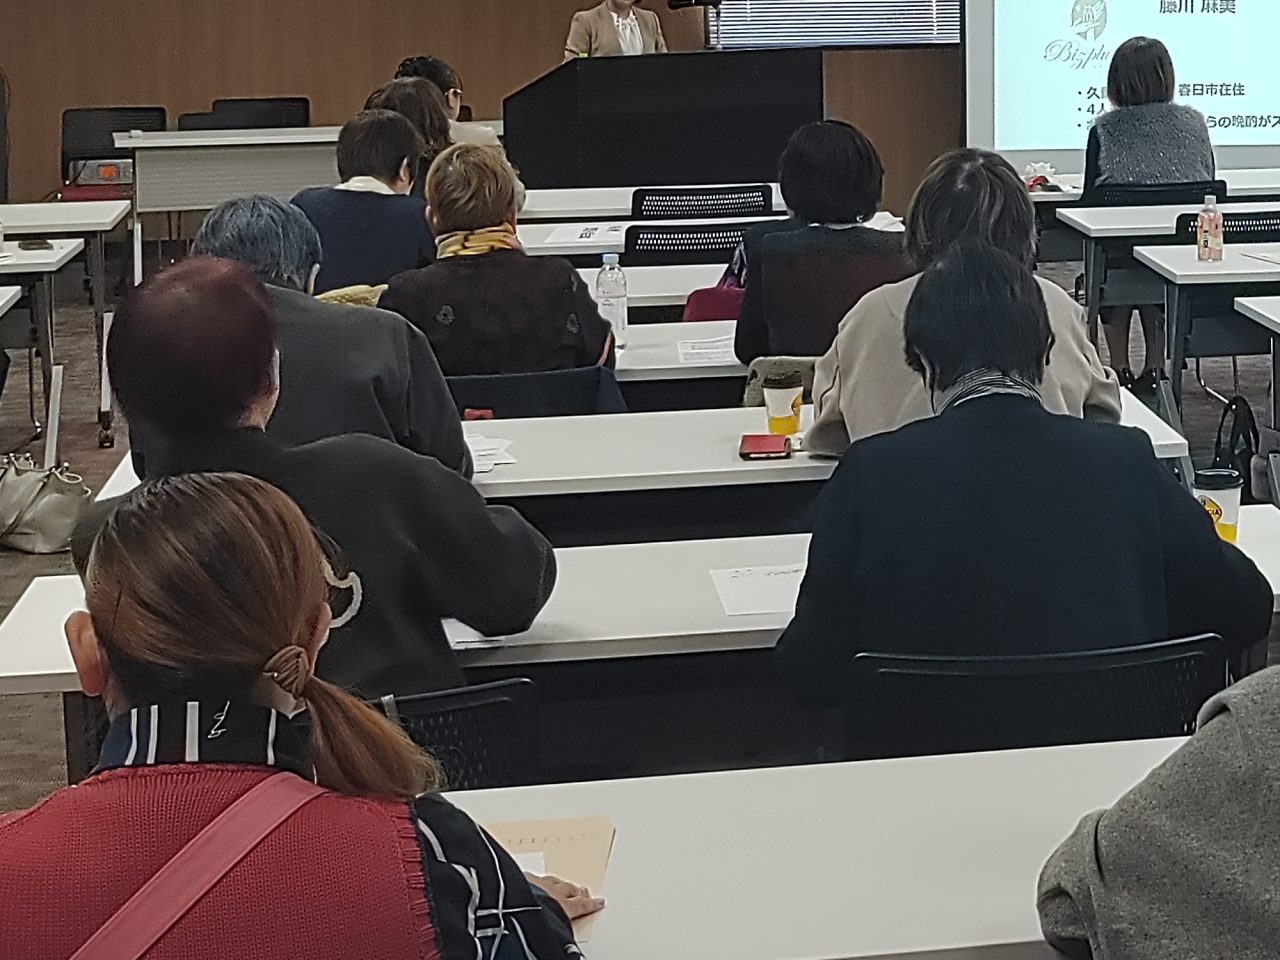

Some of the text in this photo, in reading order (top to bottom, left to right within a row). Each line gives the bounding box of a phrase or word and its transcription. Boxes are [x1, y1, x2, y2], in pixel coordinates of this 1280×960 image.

[1043, 39, 1111, 70] Bizplu
[1178, 83, 1245, 97] 春日市在住
